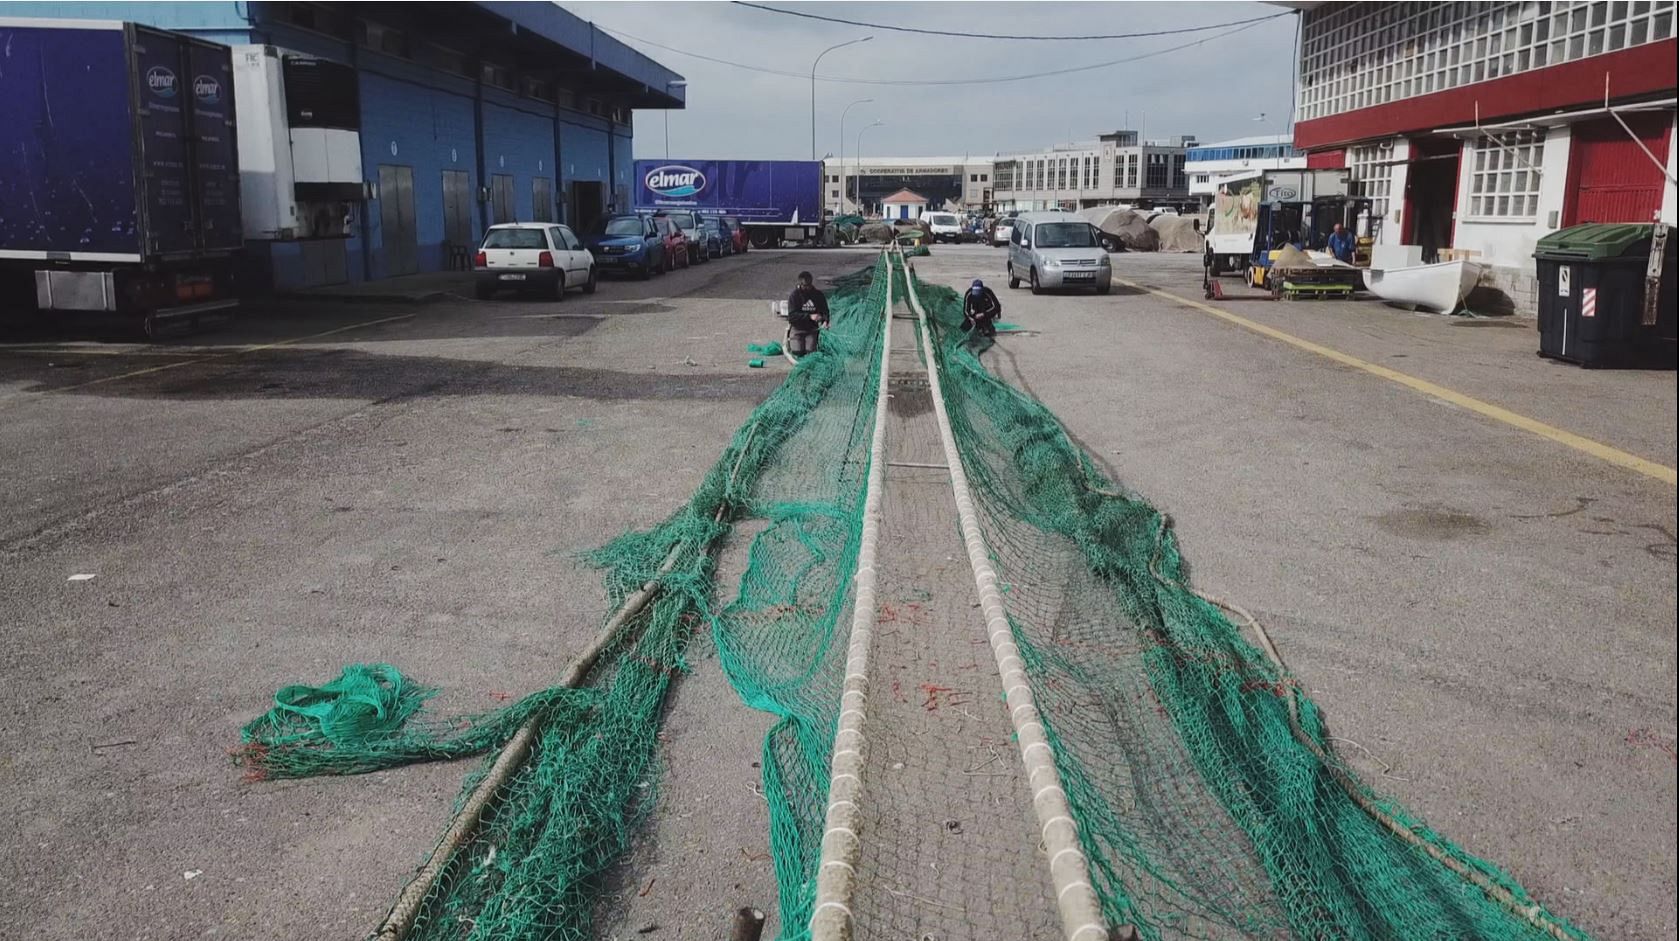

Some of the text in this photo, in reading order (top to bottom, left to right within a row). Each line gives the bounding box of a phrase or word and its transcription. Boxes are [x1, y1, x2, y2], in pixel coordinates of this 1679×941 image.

[149, 71, 175, 88] elmar
[196, 79, 218, 96] elmar
[649, 170, 699, 188] elmar
